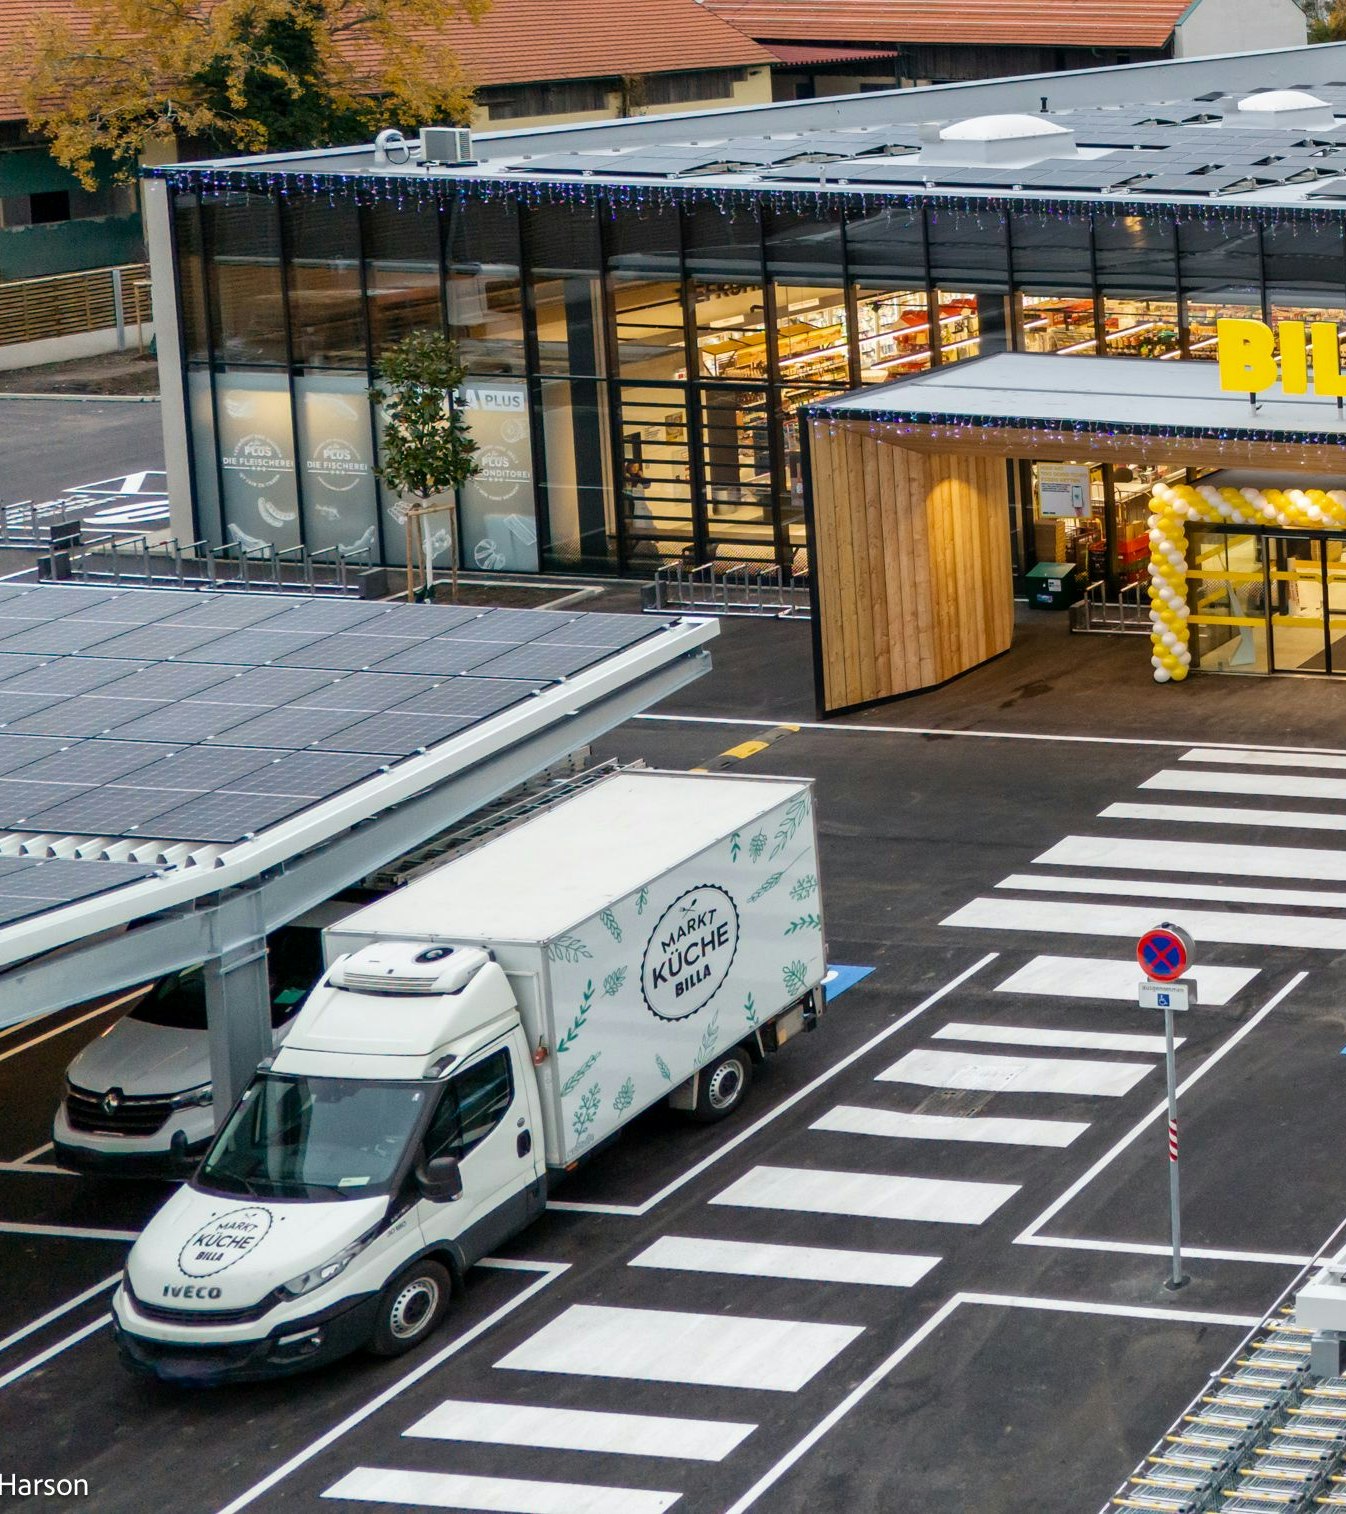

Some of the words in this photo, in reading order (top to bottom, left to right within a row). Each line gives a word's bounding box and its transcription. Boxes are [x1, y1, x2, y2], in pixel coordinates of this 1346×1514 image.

[485, 394, 521, 408] PLUS
[244, 446, 272, 457] PLUS
[323, 449, 351, 460] PLUS
[223, 457, 237, 465] DIE
[239, 458, 294, 467] FLEISCHEREI
[307, 460, 321, 468] DIE
[323, 461, 367, 471] FISCHEREI
[481, 458, 509, 467] PLUS
[481, 469, 531, 479] ONDITOREI
[661, 909, 717, 954] MARKT
[652, 922, 729, 989] KÜCHE
[675, 964, 711, 998] BILLA
[216, 1222, 258, 1232] MARKT
[193, 1232, 255, 1249] KÜCHE
[195, 1251, 224, 1261] BILLA
[162, 1284, 222, 1299] IVECO
